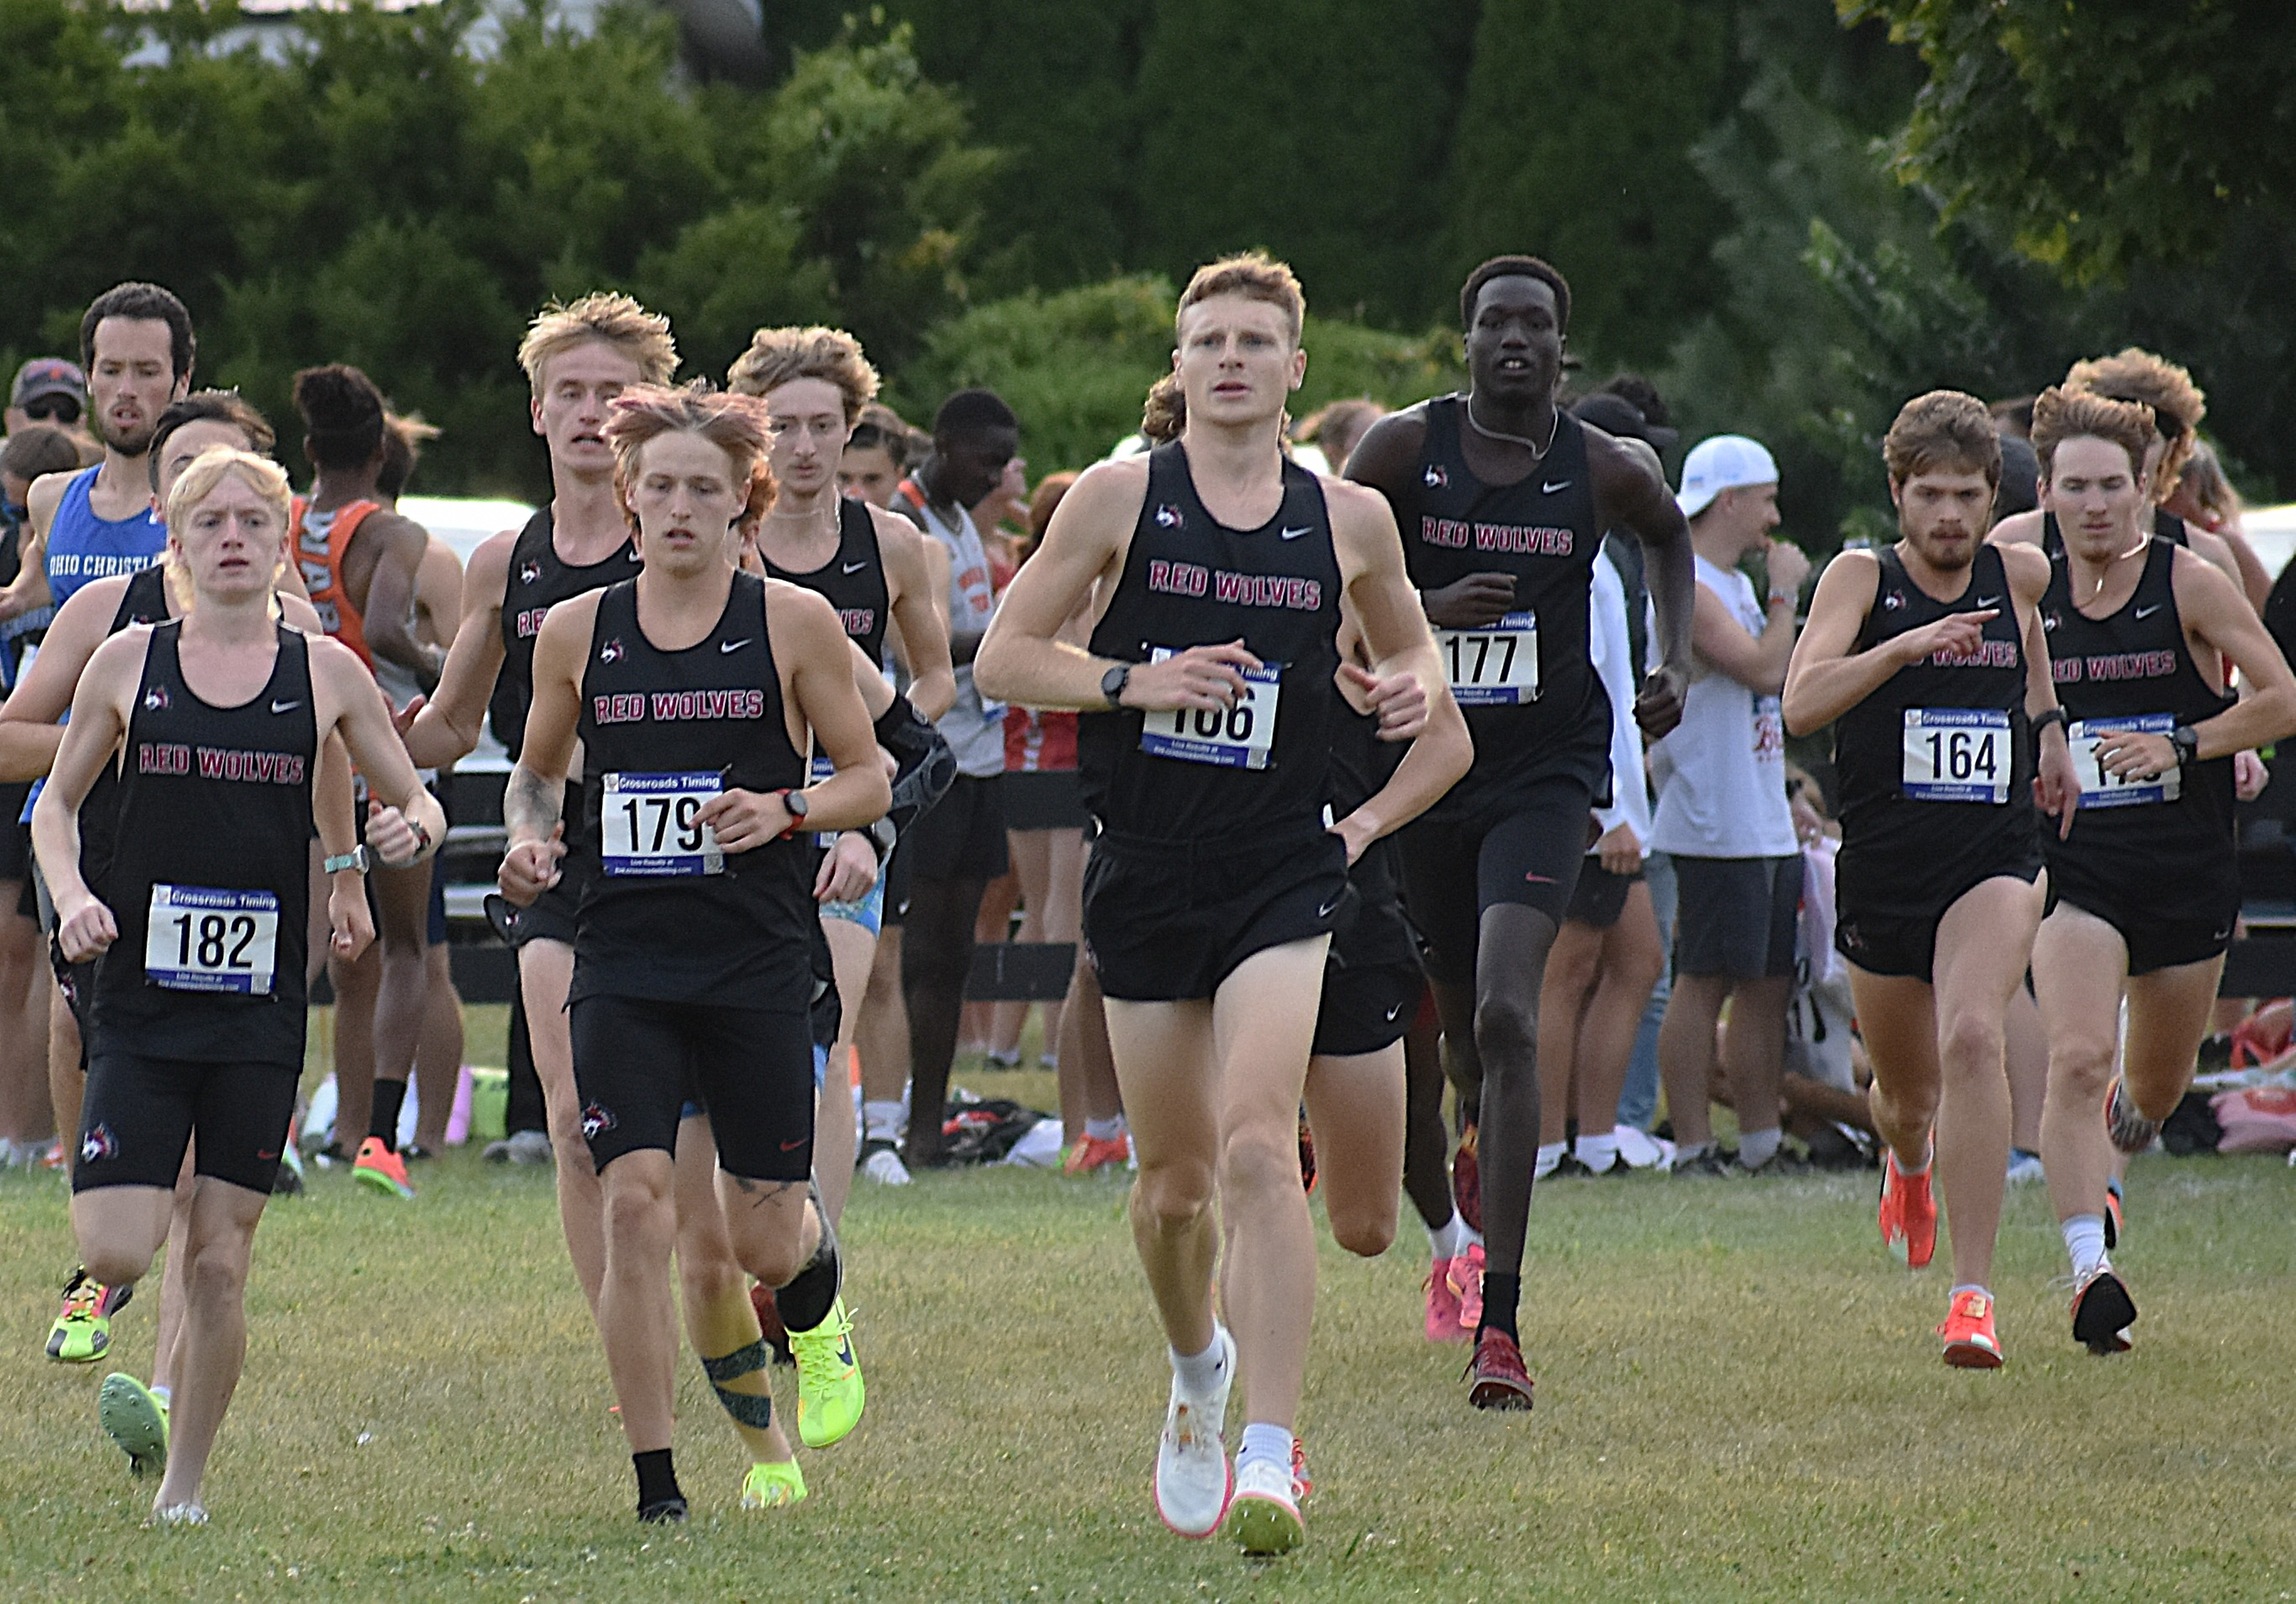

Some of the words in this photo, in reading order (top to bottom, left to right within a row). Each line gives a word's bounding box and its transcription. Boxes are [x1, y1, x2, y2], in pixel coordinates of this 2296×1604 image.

[1422, 515, 1469, 547] RED
[1474, 523, 1573, 556] WOLVES
[50, 554, 80, 577] OHIO
[1149, 559, 1208, 597] RED
[1215, 570, 1321, 611] WOLVES
[518, 607, 548, 638] RE
[1446, 636, 1517, 683] 177
[2053, 657, 2082, 683] ED
[2086, 649, 2176, 681] WOLVES
[594, 693, 645, 725] RED
[652, 689, 764, 721] WOLVES
[139, 743, 190, 776] RED
[197, 746, 304, 786] WOLVES
[1926, 732, 1997, 780] 164
[619, 777, 679, 790] Crossroads
[681, 776, 720, 790] Timing
[622, 797, 704, 852] 179
[172, 890, 237, 908] Crossroads
[239, 894, 277, 910] Timing
[173, 913, 257, 969] 182
